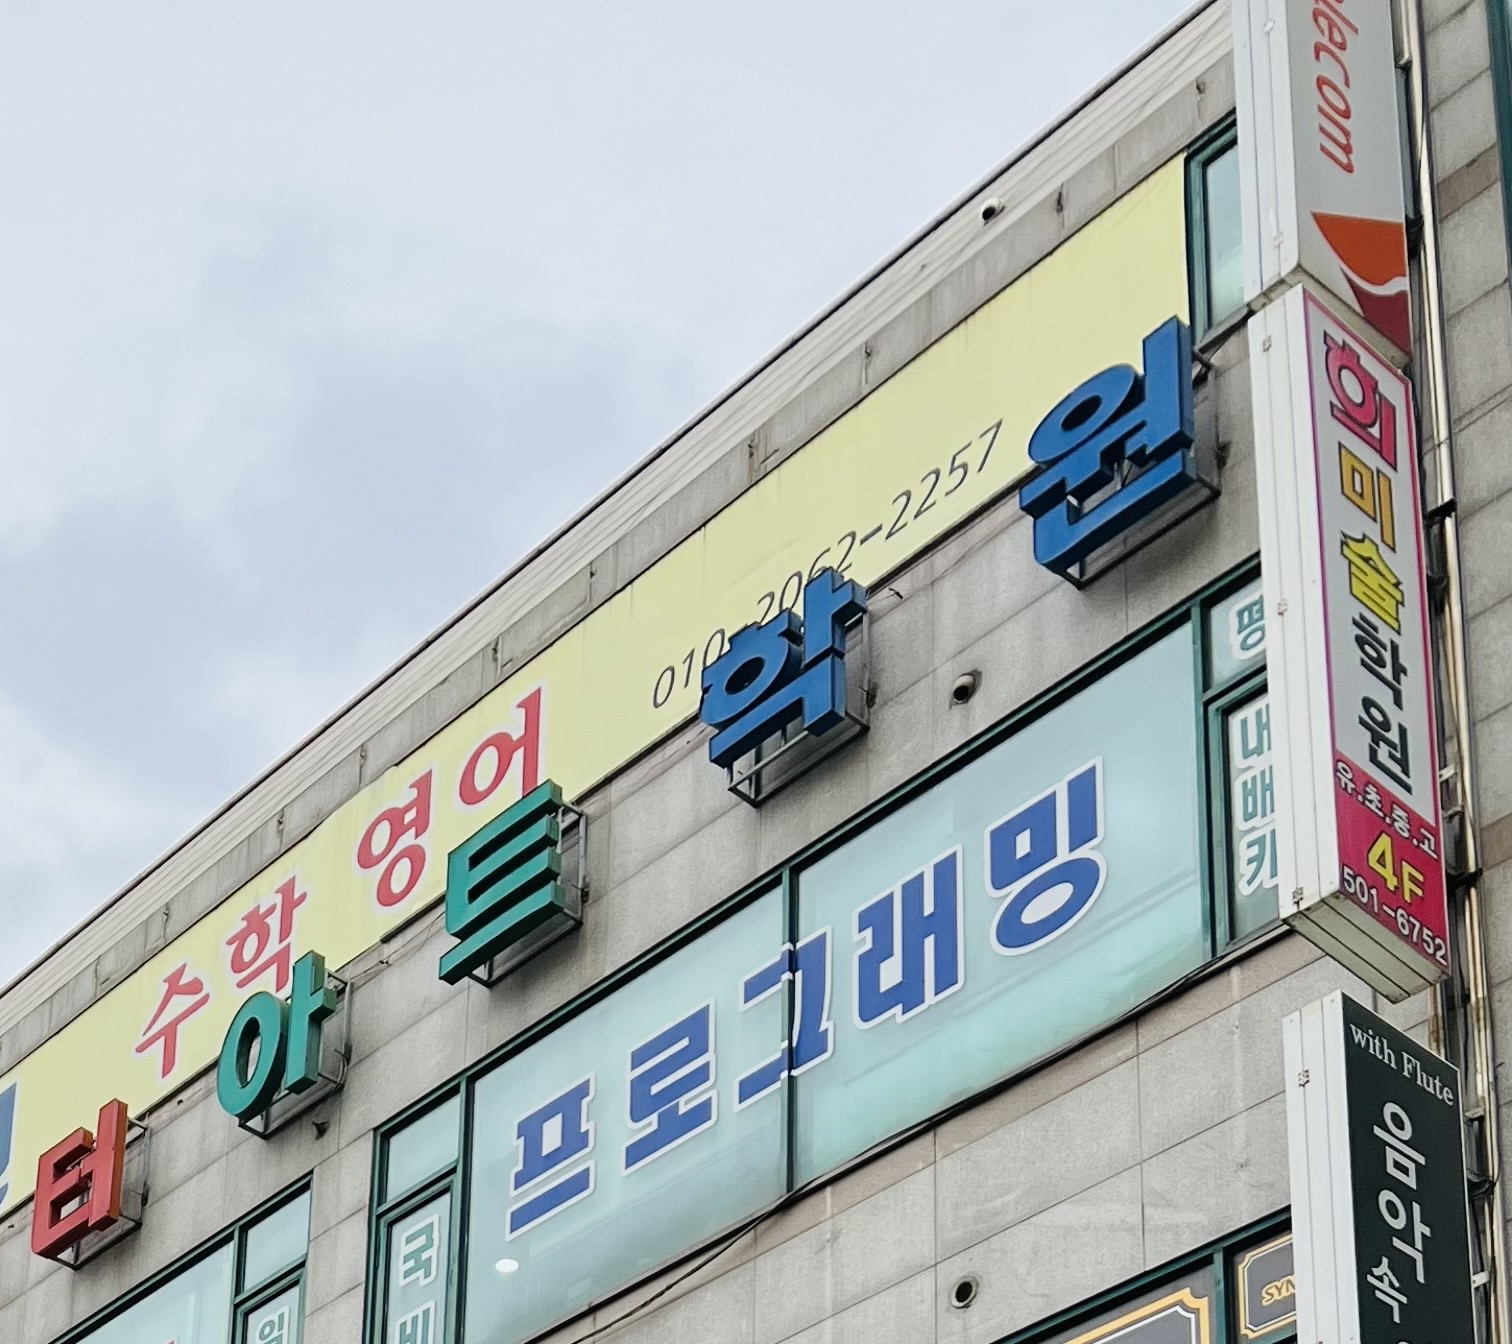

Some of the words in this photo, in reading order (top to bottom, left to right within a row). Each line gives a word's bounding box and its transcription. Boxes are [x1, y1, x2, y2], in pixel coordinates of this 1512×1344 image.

[216, 779, 563, 1120] 아트
[700, 316, 1196, 768] 학원
[135, 872, 308, 1082] 수학
[354, 682, 546, 910] 영어
[1342, 867, 1448, 966] 501-6752
[1367, 832, 1425, 905] 4F
[506, 760, 1104, 1240] 프로그래밍
[1349, 1020, 1394, 1073] with
[1401, 1049, 1455, 1108] Flute
